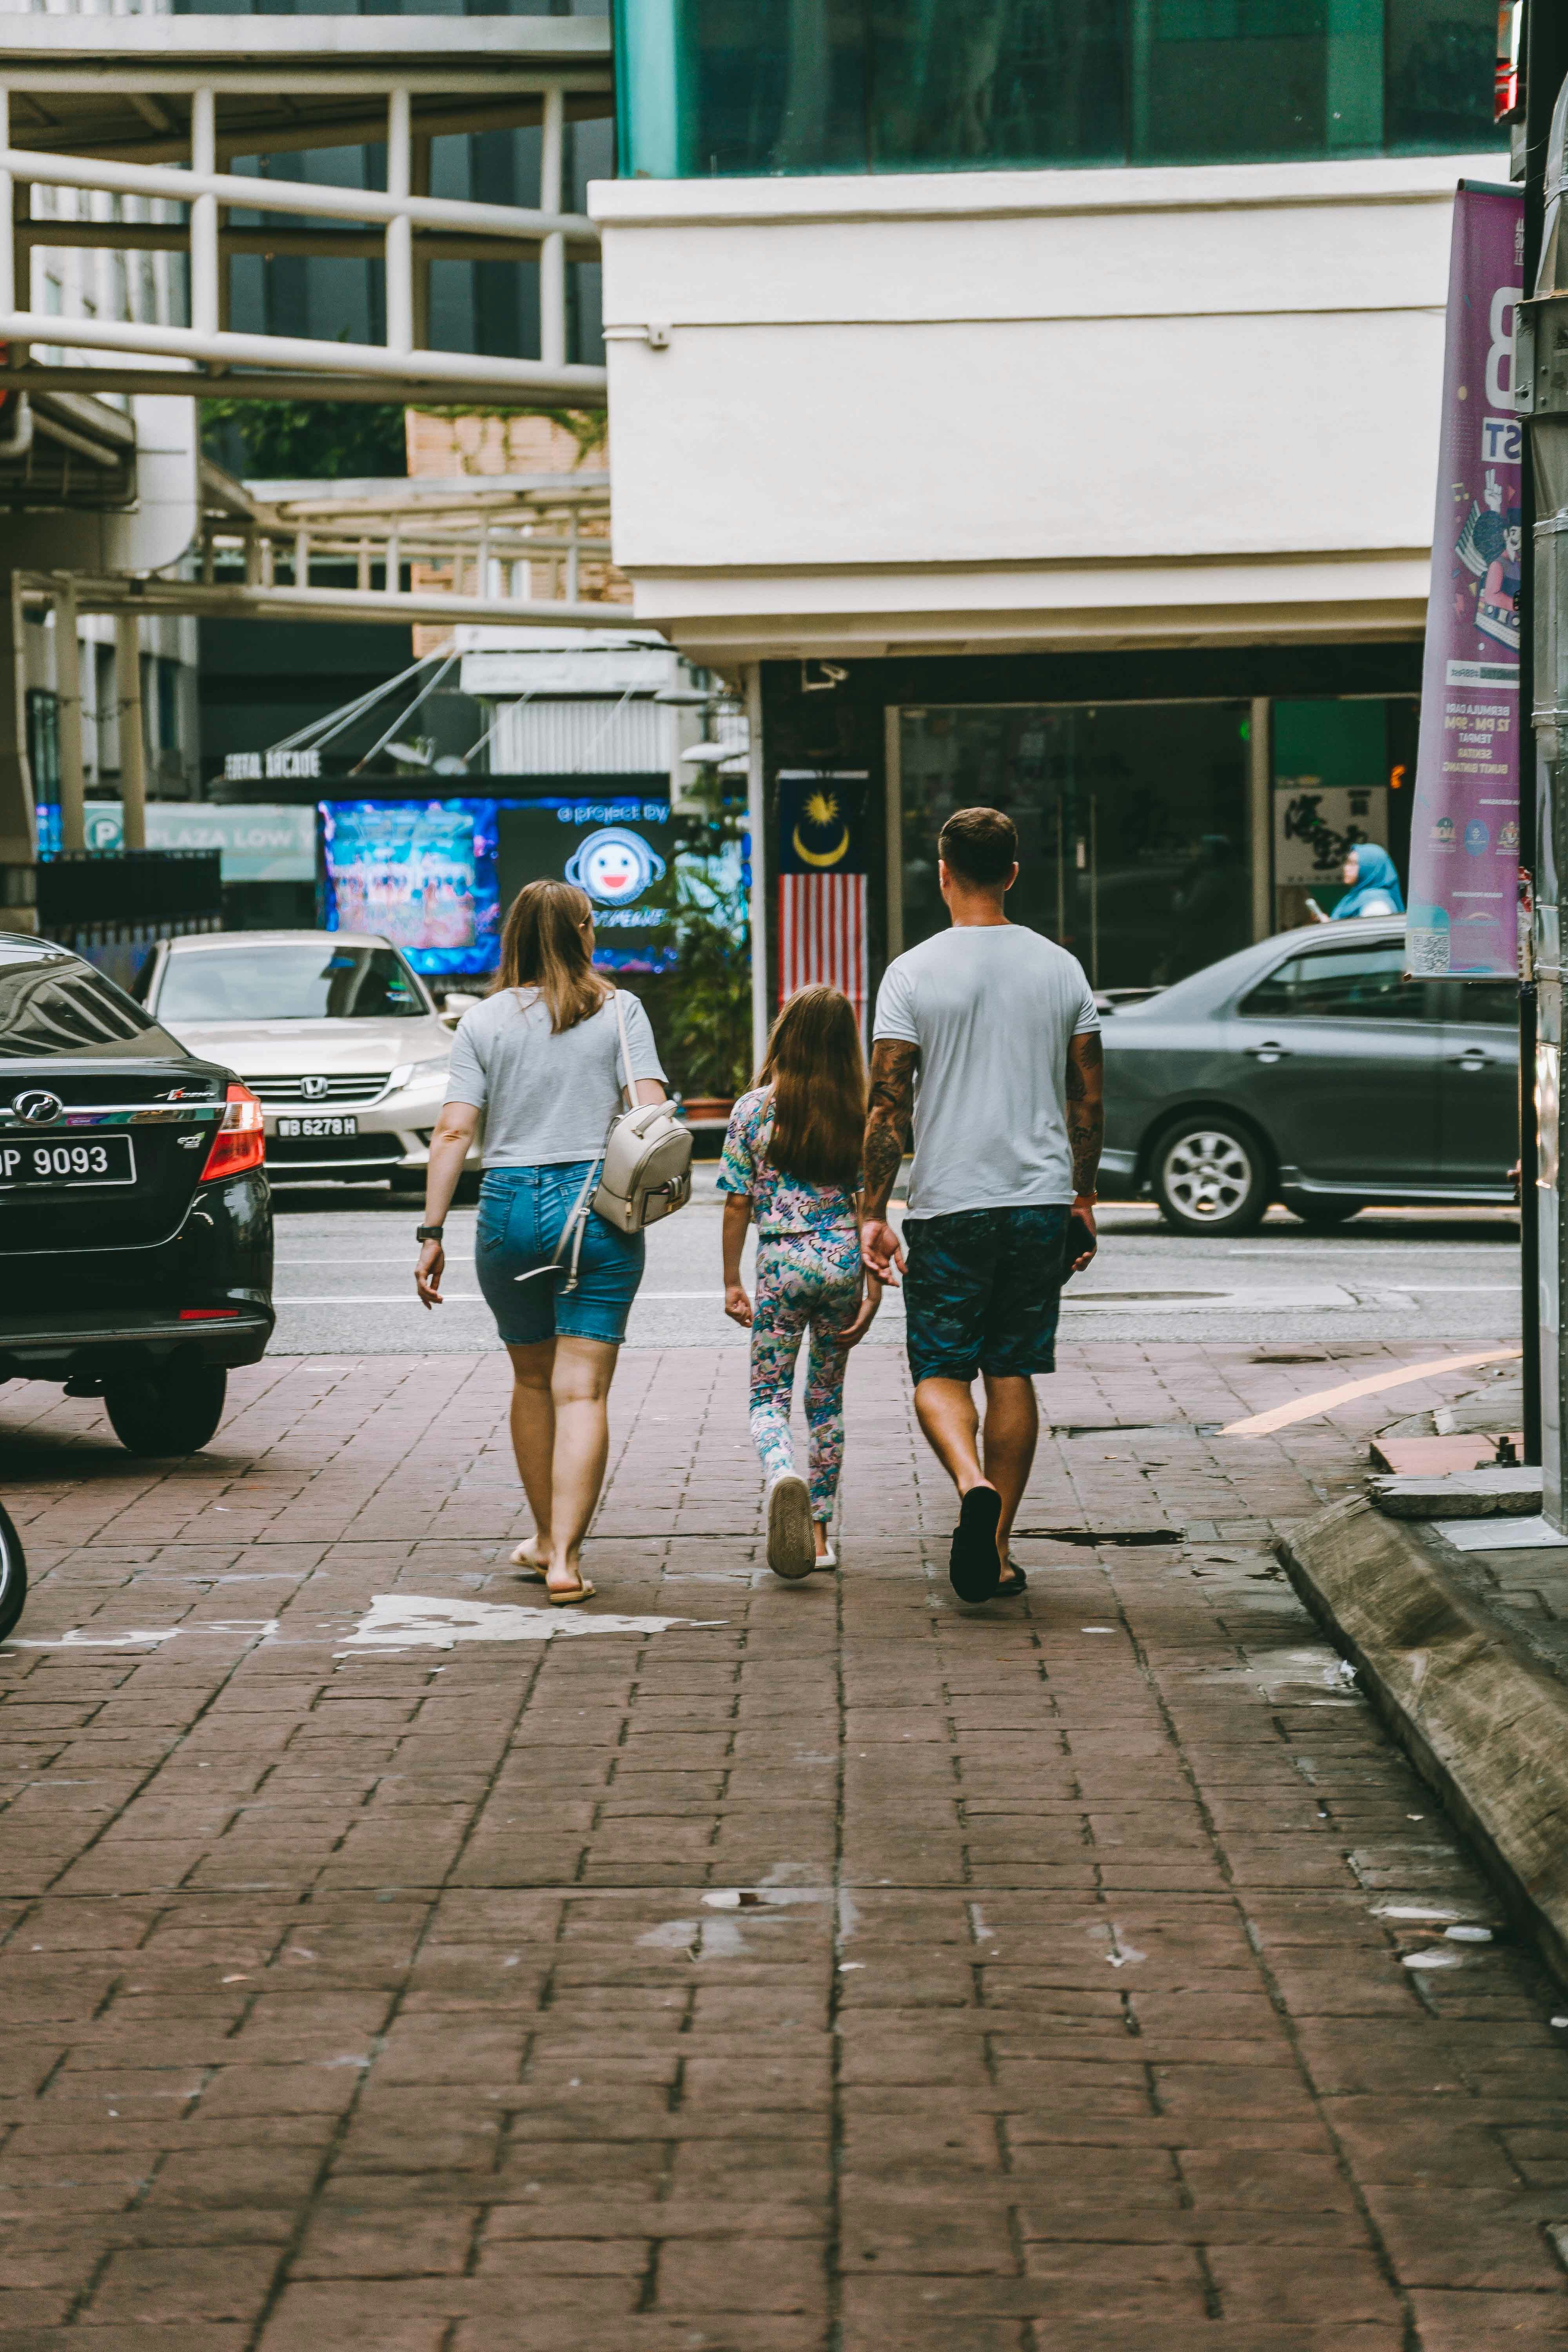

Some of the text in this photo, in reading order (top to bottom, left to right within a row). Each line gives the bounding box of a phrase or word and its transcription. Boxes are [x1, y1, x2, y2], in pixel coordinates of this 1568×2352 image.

[575, 804, 641, 826] project
[643, 803, 669, 825] by
[234, 828, 292, 848] LOW
[302, 1119, 342, 1135] 6278
[33, 1147, 108, 1174] 9093
